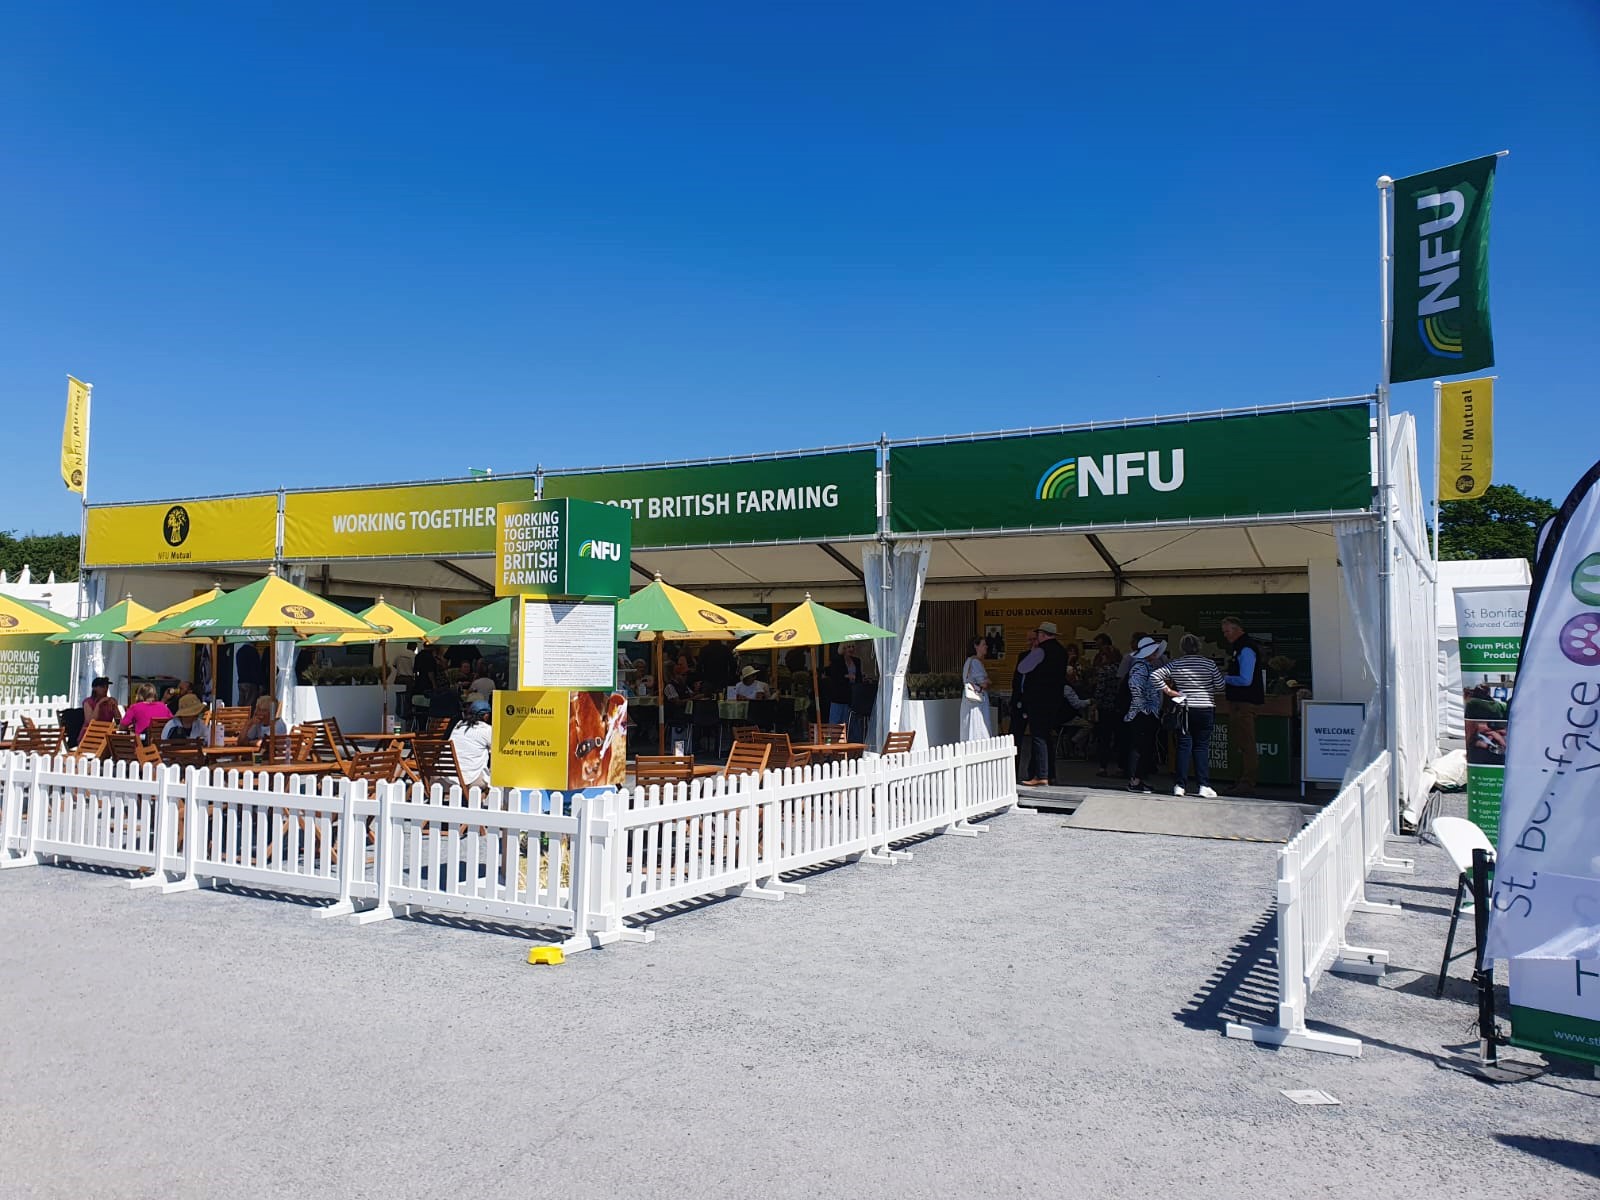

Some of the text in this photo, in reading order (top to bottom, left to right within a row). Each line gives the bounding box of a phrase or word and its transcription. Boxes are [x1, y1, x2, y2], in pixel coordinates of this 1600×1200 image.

[1417, 189, 1466, 317] NFU
[1461, 389, 1474, 471] NFU Mutual
[74, 439, 82, 466] NFU
[1077, 448, 1185, 498] NFU
[648, 493, 730, 519] BRITISH
[736, 484, 839, 514] FARMING
[332, 507, 497, 534] WORKING TOGETHER
[504, 510, 560, 528] WORKING
[504, 525, 560, 541] TOGETHER
[504, 538, 560, 553] TO SUPPORT
[590, 539, 621, 562] NFU
[158, 551, 192, 561] NFU Mutual
[503, 551, 558, 571] BRITISH
[503, 569, 558, 586] FARMING
[984, 606, 1094, 617] MEET OUR DEVON FARMERS
[1463, 607, 1527, 619] St Bonifac
[189, 618, 220, 628] NFU
[619, 623, 649, 631] NFU
[1464, 620, 1501, 629] Advanced
[1465, 642, 1494, 650] Ovum
[1495, 641, 1514, 650] Pick
[0, 650, 40, 663] WORKING
[0, 662, 40, 675] TOGETHER
[8, 674, 40, 686] SUPPORT
[516, 706, 555, 715] NFU Mutual
[1313, 727, 1358, 736] WELCOME
[509, 738, 551, 747] We're the UK's
[523, 749, 537, 757] rural
[537, 749, 558, 758] insurer
[1492, 870, 1538, 918] St.
